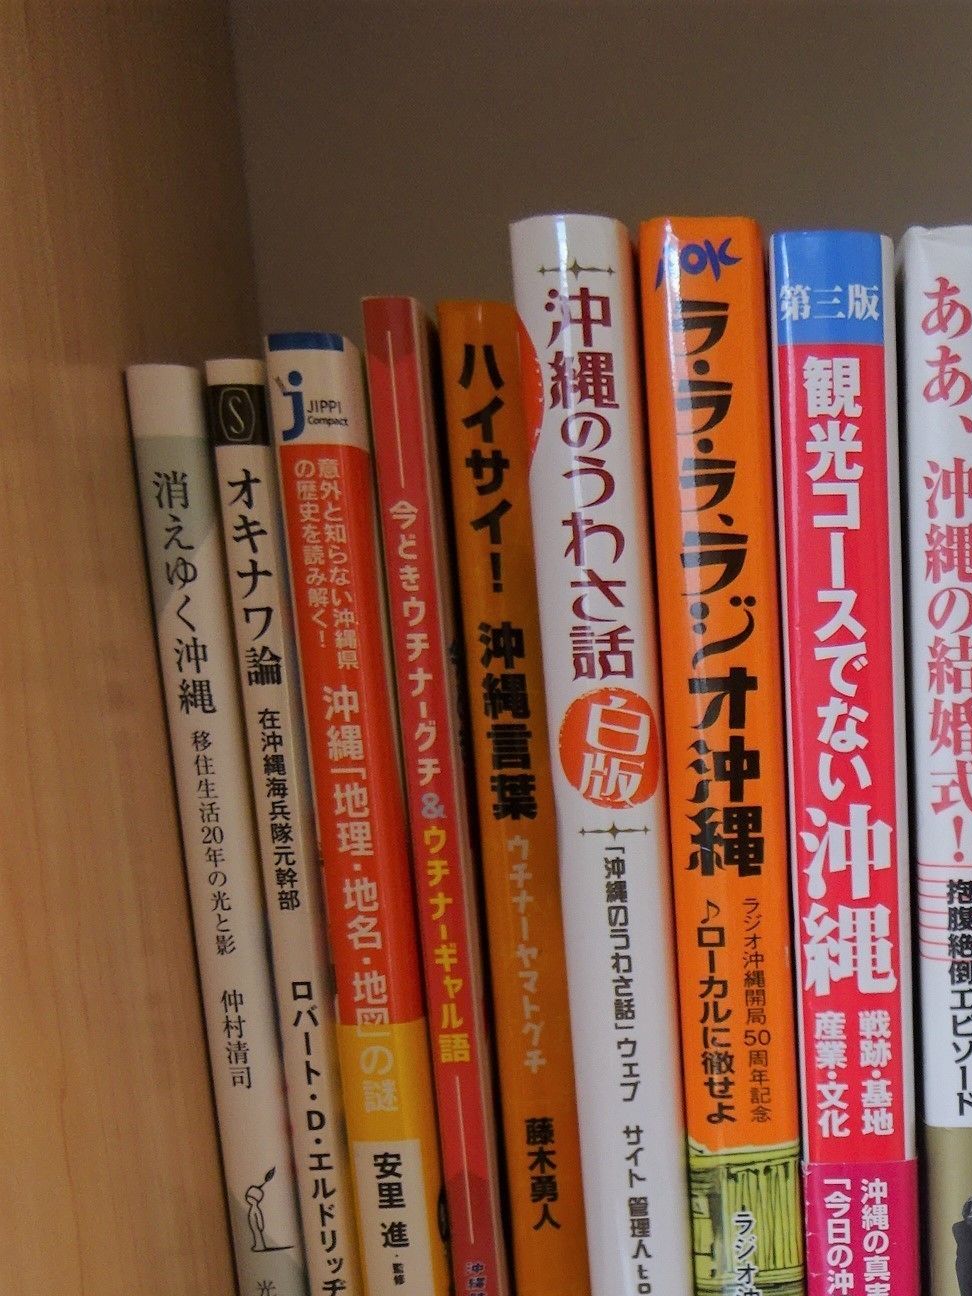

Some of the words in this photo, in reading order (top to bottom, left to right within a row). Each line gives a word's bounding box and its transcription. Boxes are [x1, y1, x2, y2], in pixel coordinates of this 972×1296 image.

[780, 284, 880, 321] 第三版
[307, 415, 349, 428] Compact
[458, 344, 512, 593] ハイサイ！
[545, 287, 635, 682] 沖縄のうわさ話
[152, 470, 217, 714] 消えゆく沖縄
[227, 468, 283, 687] オキナワ論
[318, 457, 360, 671] 意外と知らない沖縄県
[478, 621, 538, 820] 沖縄言葉
[580, 695, 651, 808] 白版
[798, 355, 898, 998] 観光コースでない沖縄
[191, 729, 237, 956] 移住生活20年の光と影
[257, 707, 301, 912] 在沖縄海兵隊元幹部
[321, 683, 399, 1114] 沖縄「地理・地名・地図」の謎
[220, 989, 252, 1089] 仲村清司
[507, 836, 548, 1073] ウチナーヤマトグチ
[742, 897, 772, 1123] ラジオ沖縄開局50周年記念
[524, 1118, 562, 1231] 藤木勇人
[623, 1125, 646, 1189] サイト
[815, 1011, 851, 1139] 産業・文化
[857, 1010, 895, 1136] 戦跡・基地
[374, 1152, 406, 1210] 安里
